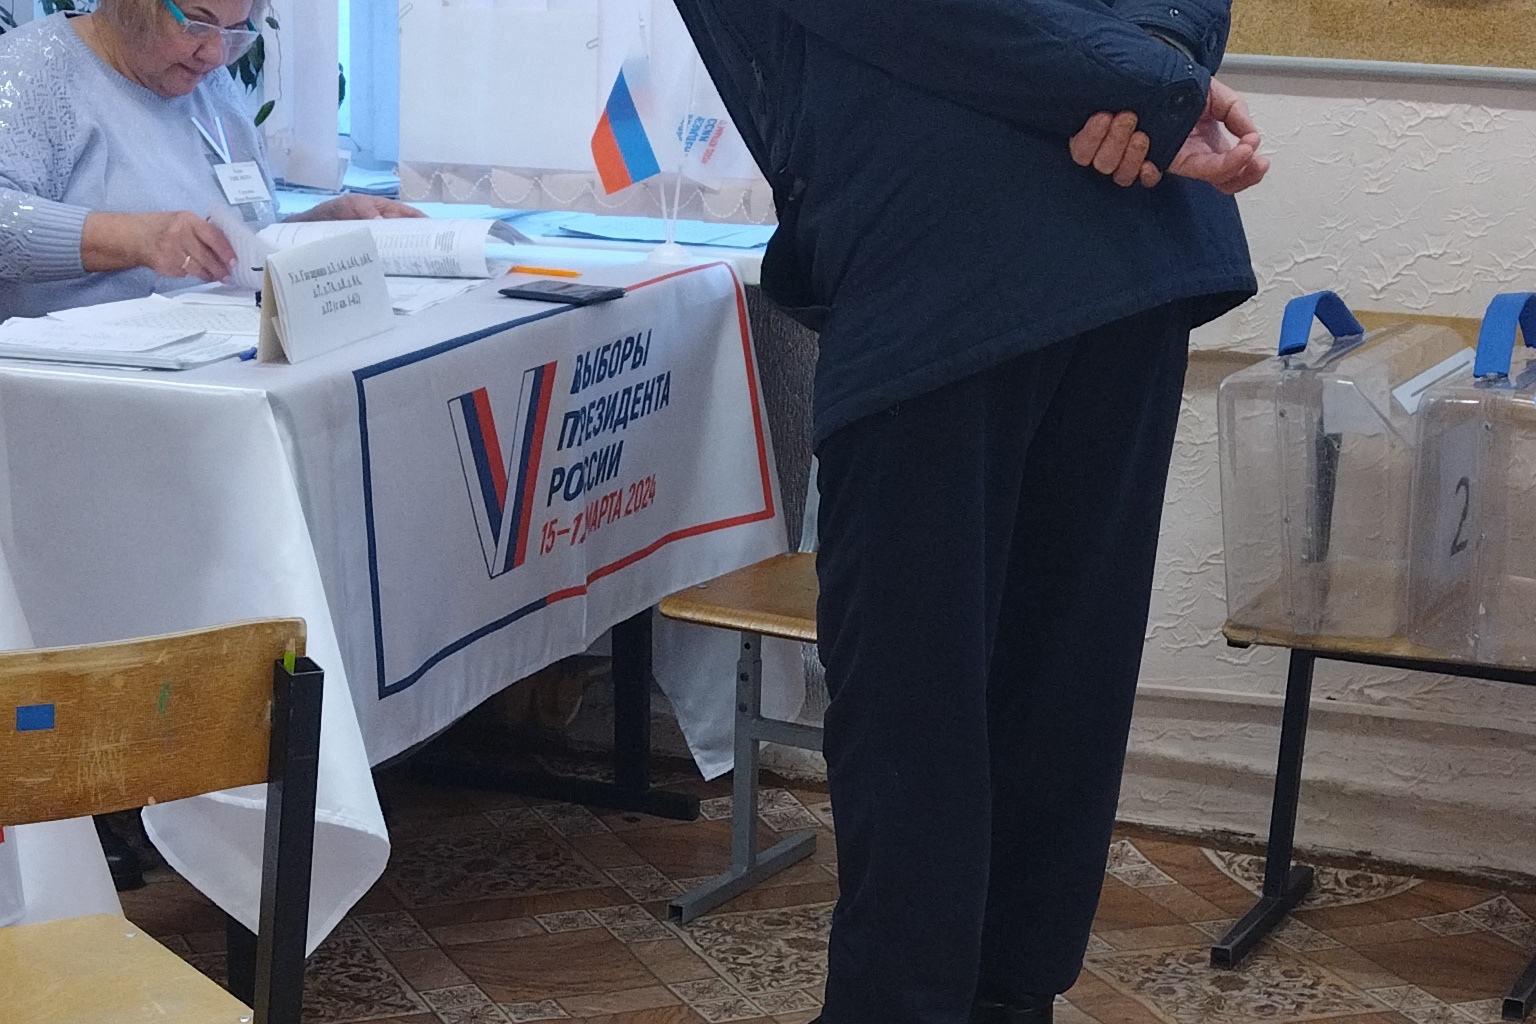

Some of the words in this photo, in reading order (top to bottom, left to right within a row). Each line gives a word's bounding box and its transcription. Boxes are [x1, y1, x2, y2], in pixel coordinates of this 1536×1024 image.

[569, 328, 652, 395] ВЫБОРЫ
[556, 370, 671, 452] ПРЕЗИДЕНТА
[546, 440, 624, 508] РОССИИ
[624, 473, 657, 518] 2024
[1450, 476, 1470, 557] 2
